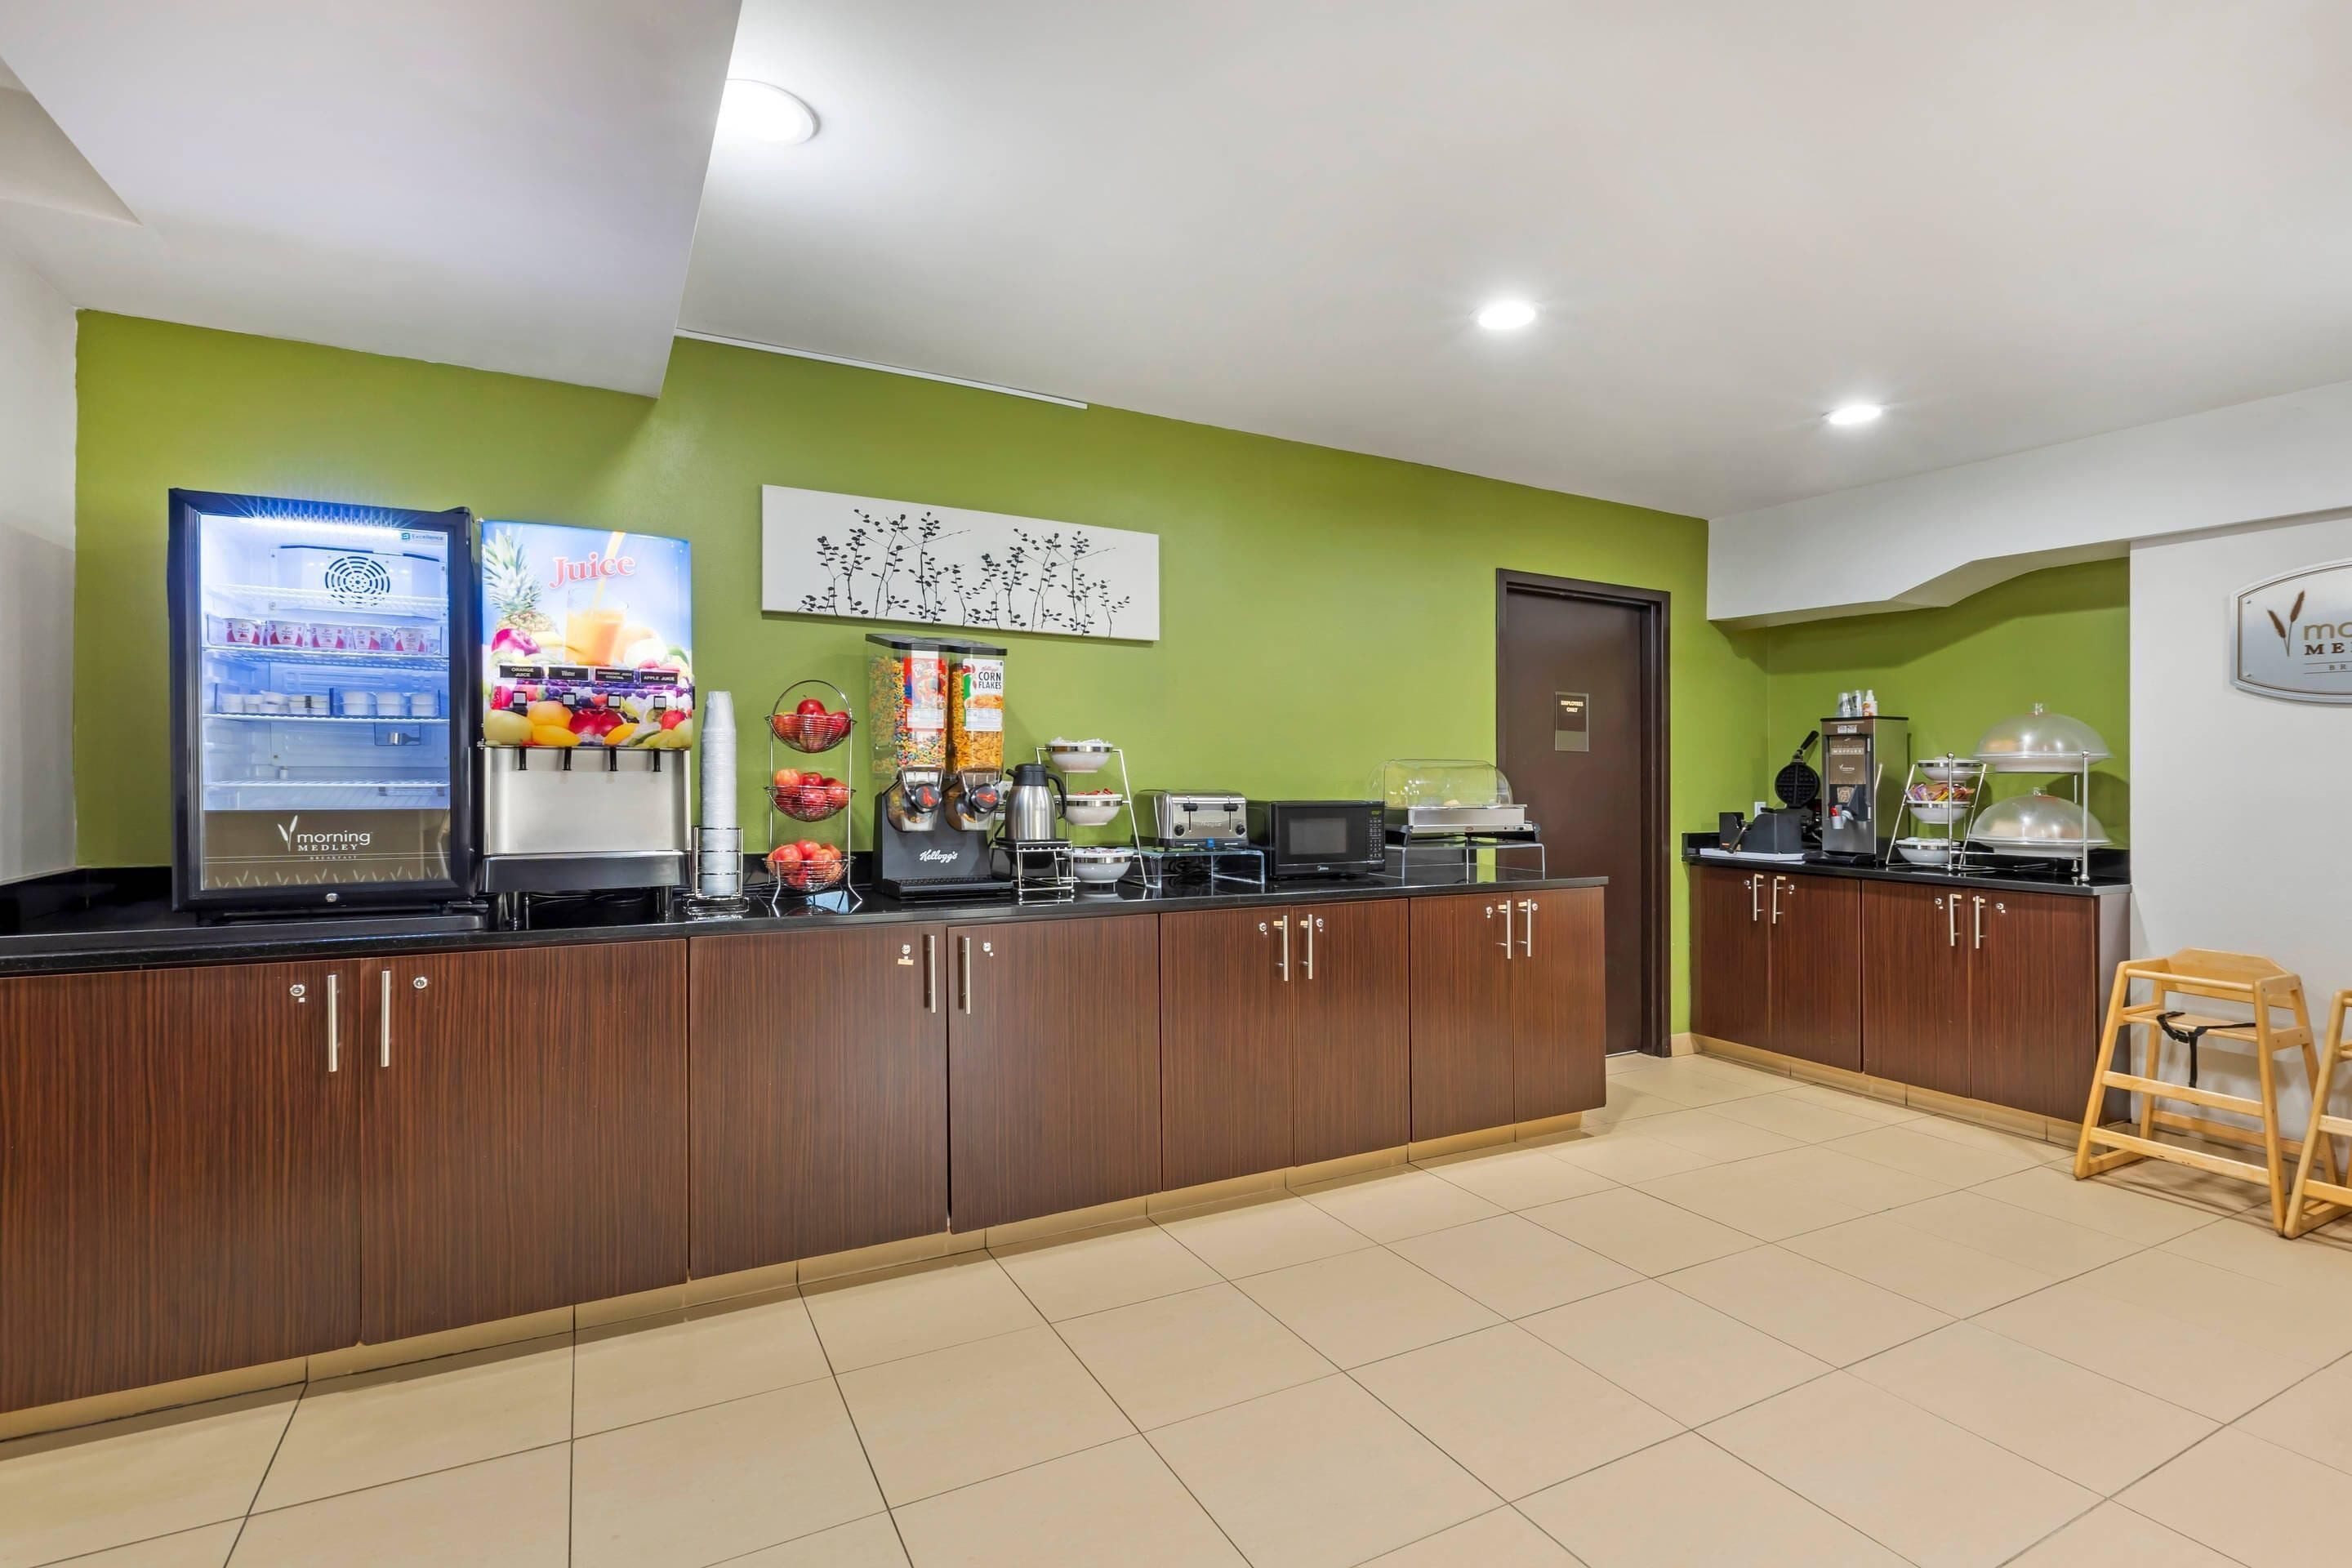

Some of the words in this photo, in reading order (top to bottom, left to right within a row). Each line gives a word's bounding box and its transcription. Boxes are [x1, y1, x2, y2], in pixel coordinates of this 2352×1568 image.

[548, 552, 635, 589] Juice
[978, 671, 1001, 681] CORN
[978, 681, 1002, 690] FLAKES
[297, 830, 371, 845] morning
[920, 849, 958, 863] Kellogg's
